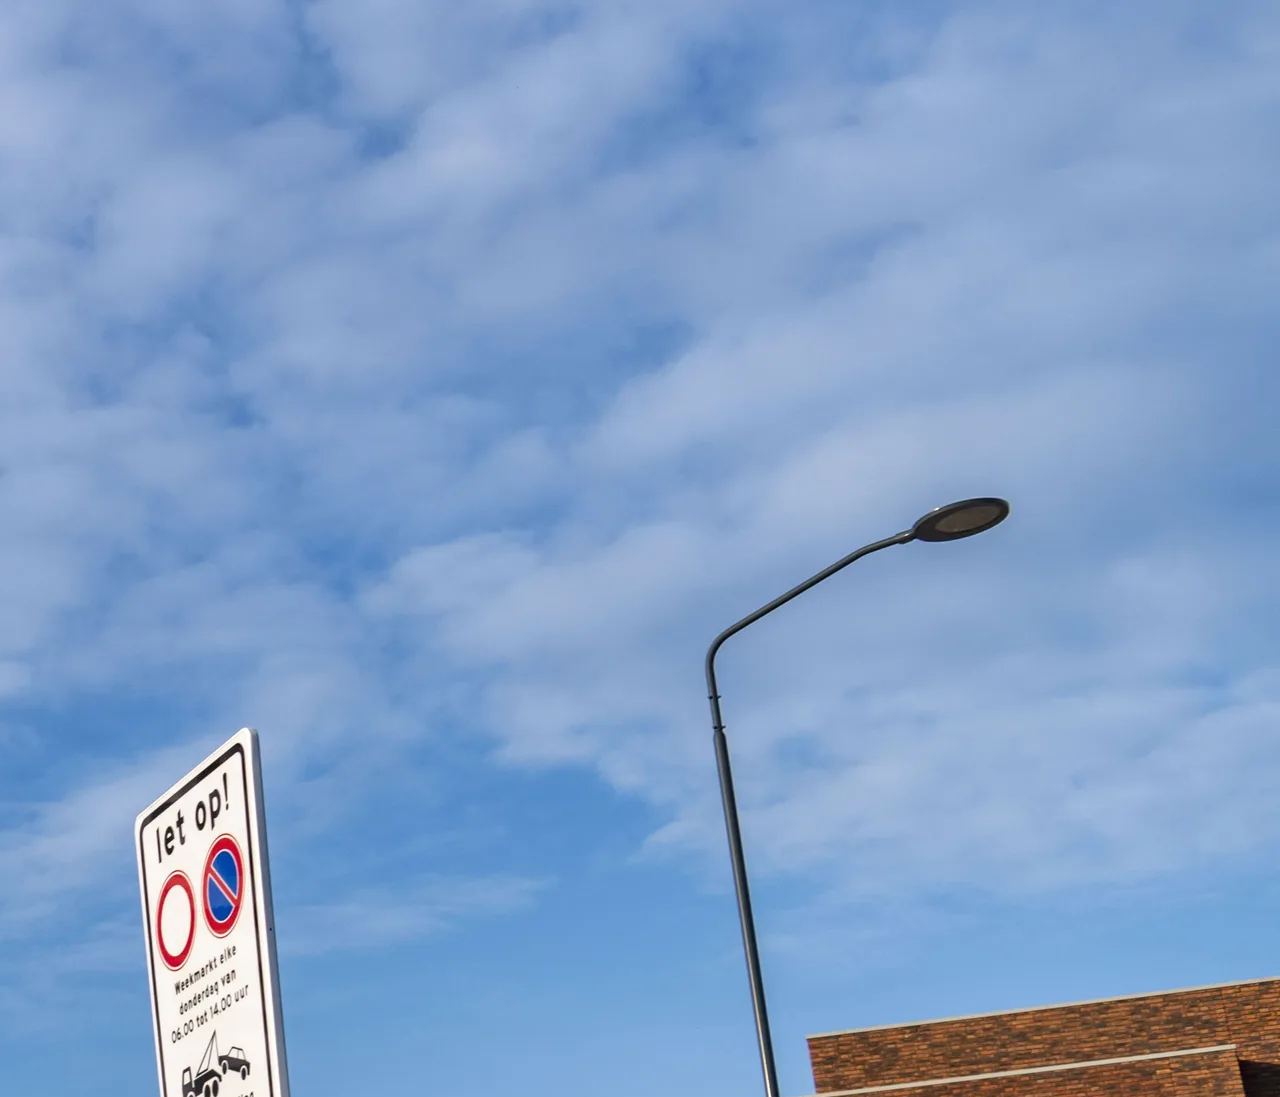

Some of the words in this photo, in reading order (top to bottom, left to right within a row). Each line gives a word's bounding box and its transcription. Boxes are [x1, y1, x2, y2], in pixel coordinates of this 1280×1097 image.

[195, 772, 229, 831] op!
[174, 959, 218, 995] Weekmarkt
[219, 945, 237, 964] elke
[179, 981, 219, 1015] donderdag
[220, 968, 237, 987] van
[171, 1019, 195, 1044] 06.00
[196, 1011, 209, 1029] tot
[209, 993, 233, 1017] 14.00
[234, 984, 250, 1003] uur
